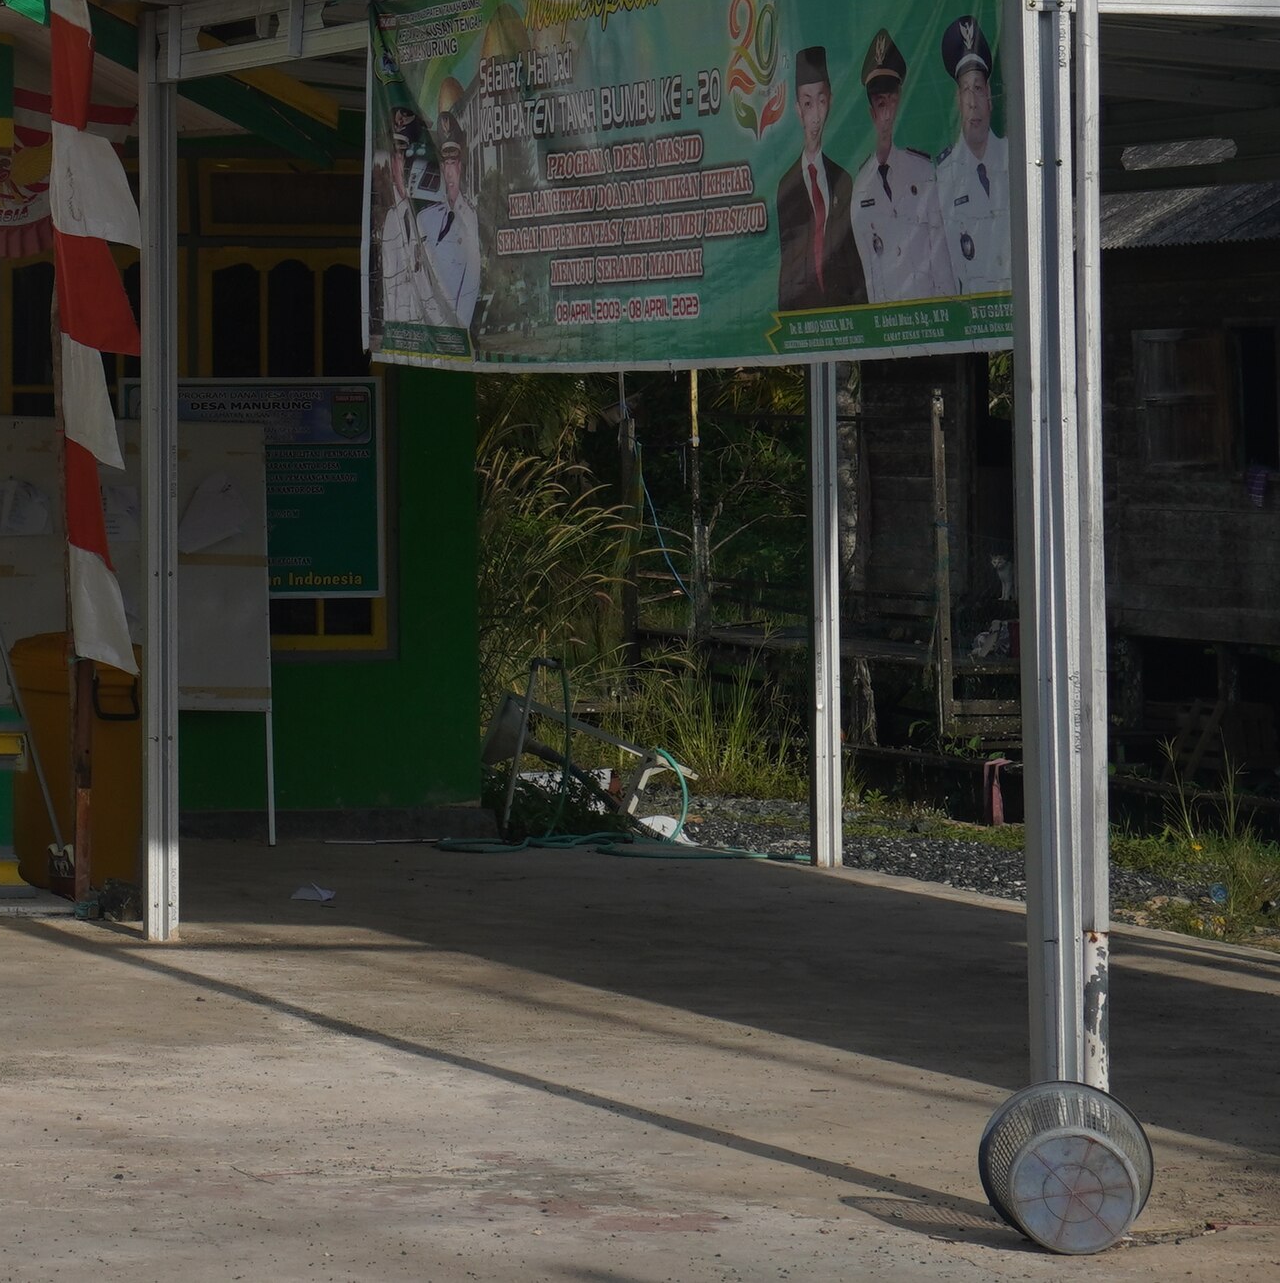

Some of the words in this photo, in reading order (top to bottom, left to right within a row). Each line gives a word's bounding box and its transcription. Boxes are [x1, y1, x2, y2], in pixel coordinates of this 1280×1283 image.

[480, 97, 555, 142] KABUPATEN
[601, 79, 656, 125] BUMBU
[660, 75, 681, 116] KE
[698, 69, 721, 112] 20
[613, 143, 646, 170] DESA
[656, 136, 702, 166] MASJID
[596, 183, 621, 210] DOA
[621, 180, 645, 207] DAN
[646, 173, 699, 205] BUMIKAN
[498, 228, 538, 255] SEBAGAI
[540, 219, 622, 250] IMPLEMENTASI
[624, 216, 661, 244] TANAH
[662, 211, 704, 240] BUMBU
[705, 203, 767, 236] BERSUJUD
[551, 258, 594, 285] MENUJU
[596, 254, 647, 282] SERAMBI
[649, 249, 703, 279] MADINAH
[556, 302, 568, 322] 08
[570, 301, 593, 321] APRIL
[596, 301, 621, 320] 2003
[629, 299, 641, 319] 08
[644, 297, 669, 318] APRIL
[672, 296, 699, 316] 2023
[191, 402, 226, 410] DESA
[230, 402, 312, 410] MANURUNG
[288, 571, 362, 586] Indonesia
